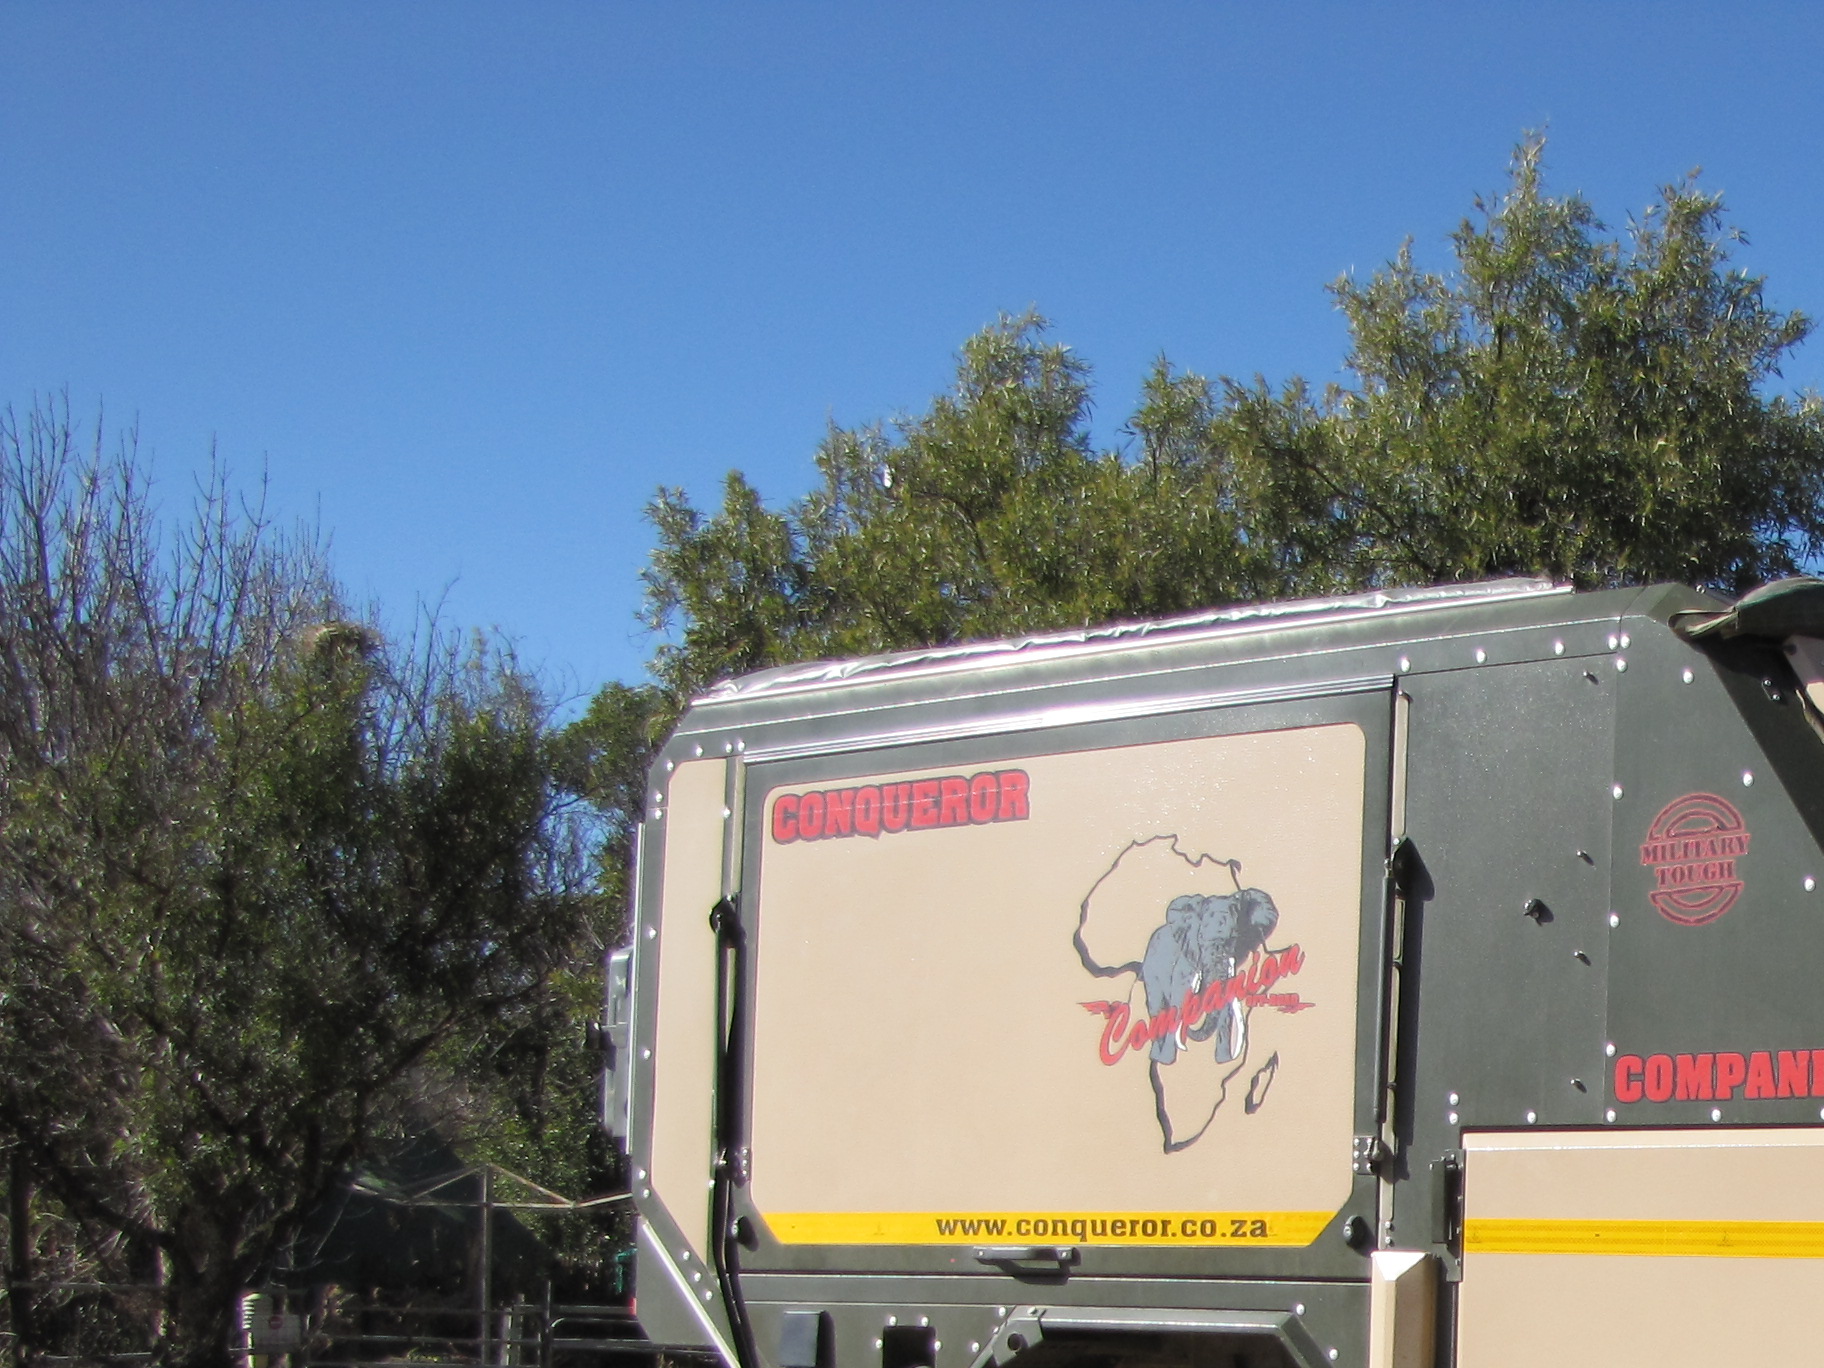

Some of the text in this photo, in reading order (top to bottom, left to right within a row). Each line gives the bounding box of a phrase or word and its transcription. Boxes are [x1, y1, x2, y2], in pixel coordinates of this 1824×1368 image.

[773, 769, 1029, 844] CONQUEROR
[1640, 833, 1751, 865] MILITARY
[1655, 860, 1736, 888] TOUGH
[1100, 943, 1306, 1066] Companion
[936, 1217, 1269, 1242] www.conqueror.co.za
